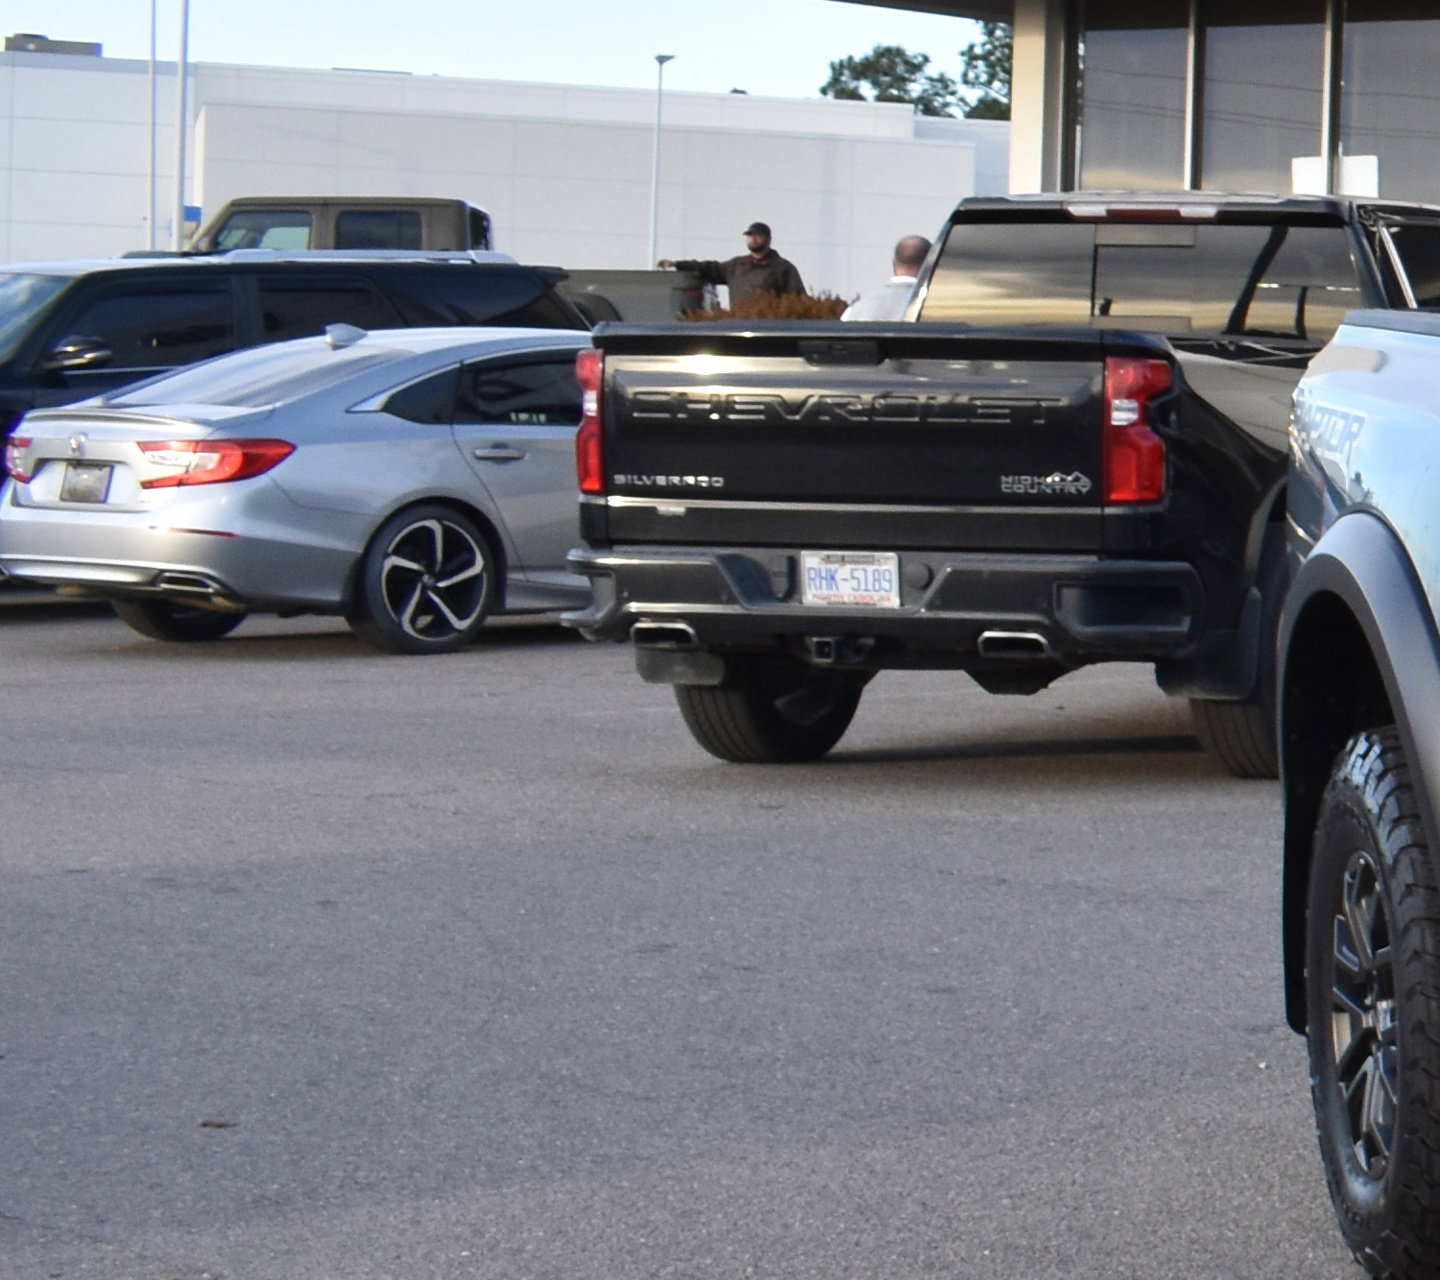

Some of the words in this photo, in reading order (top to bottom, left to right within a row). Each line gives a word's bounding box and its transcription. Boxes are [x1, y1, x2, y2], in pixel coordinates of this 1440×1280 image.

[632, 390, 1067, 424] CHEVROLET
[613, 473, 725, 488] SILVERADO
[1000, 483, 1092, 495] COUNTRY
[806, 566, 893, 593] RHK-5189
